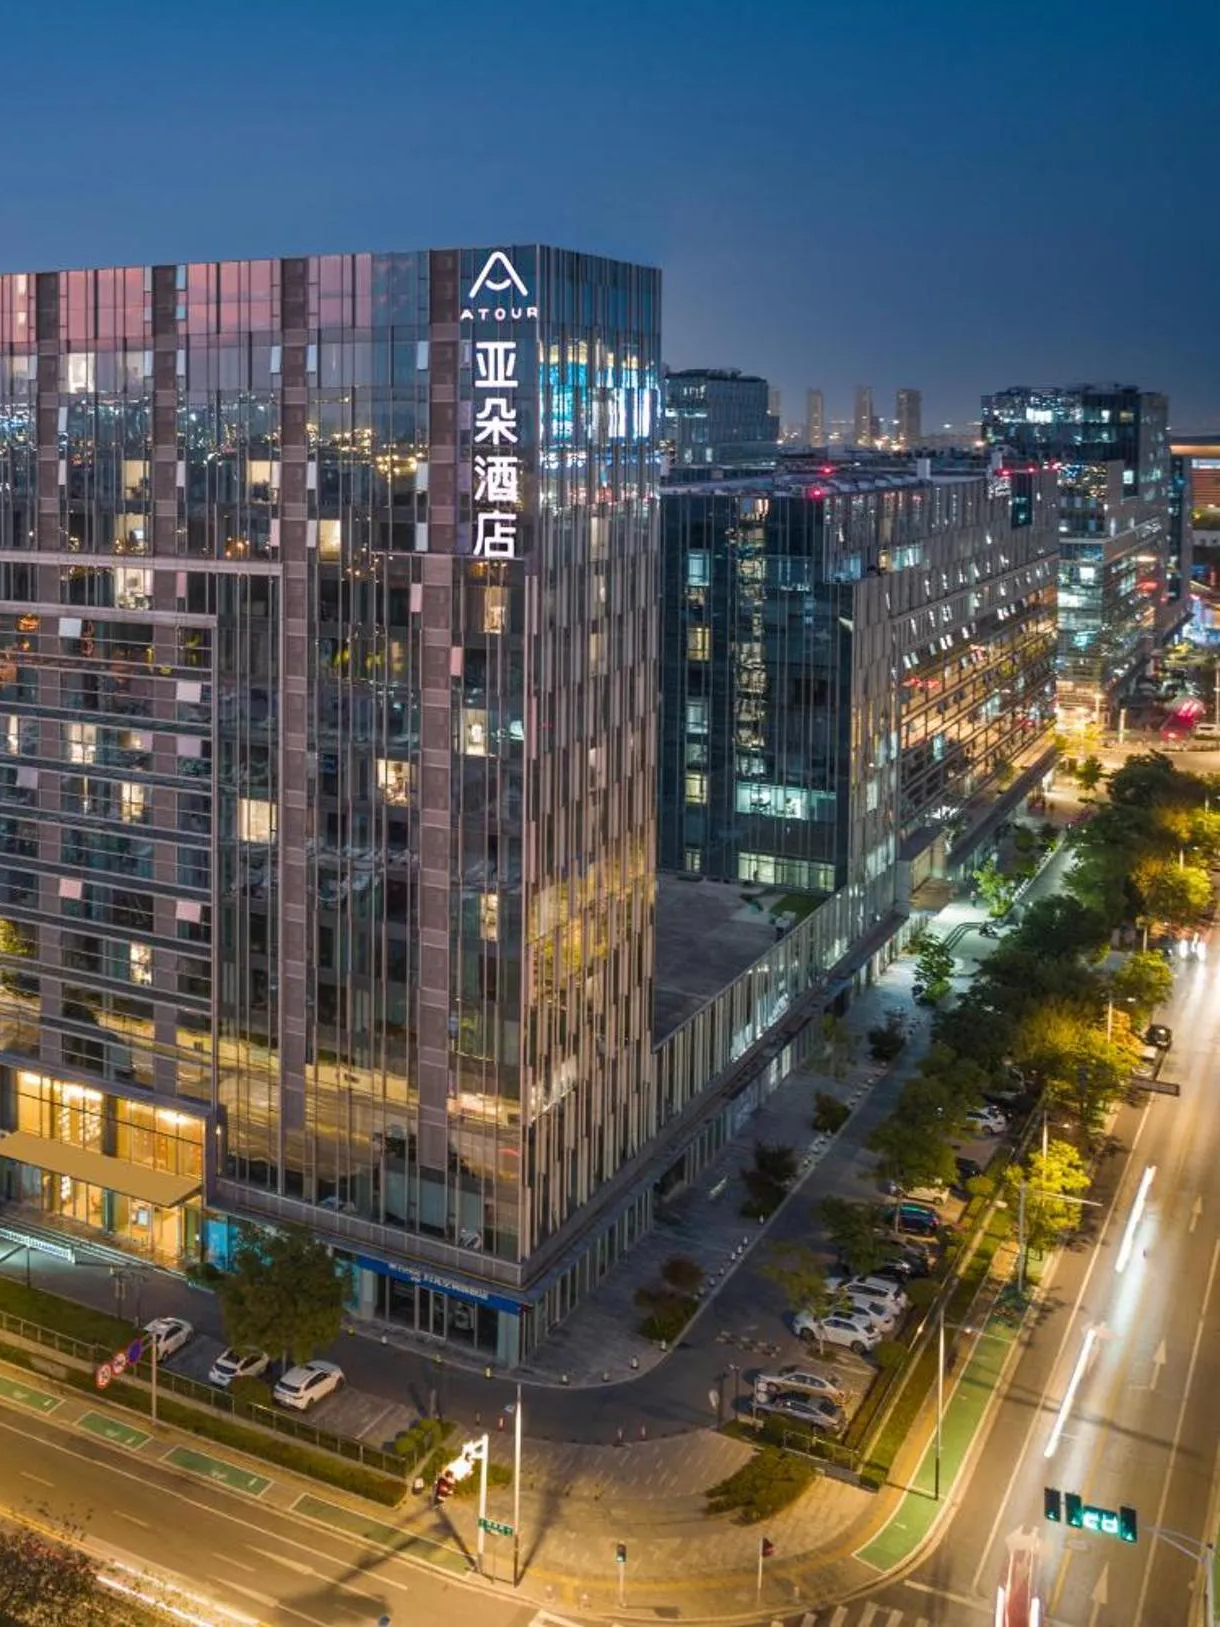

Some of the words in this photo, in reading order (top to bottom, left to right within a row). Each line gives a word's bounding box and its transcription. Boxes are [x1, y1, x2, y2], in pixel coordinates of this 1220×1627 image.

[460, 306, 538, 321] ATOUR
[473, 340, 519, 558] 亚朵酒店
